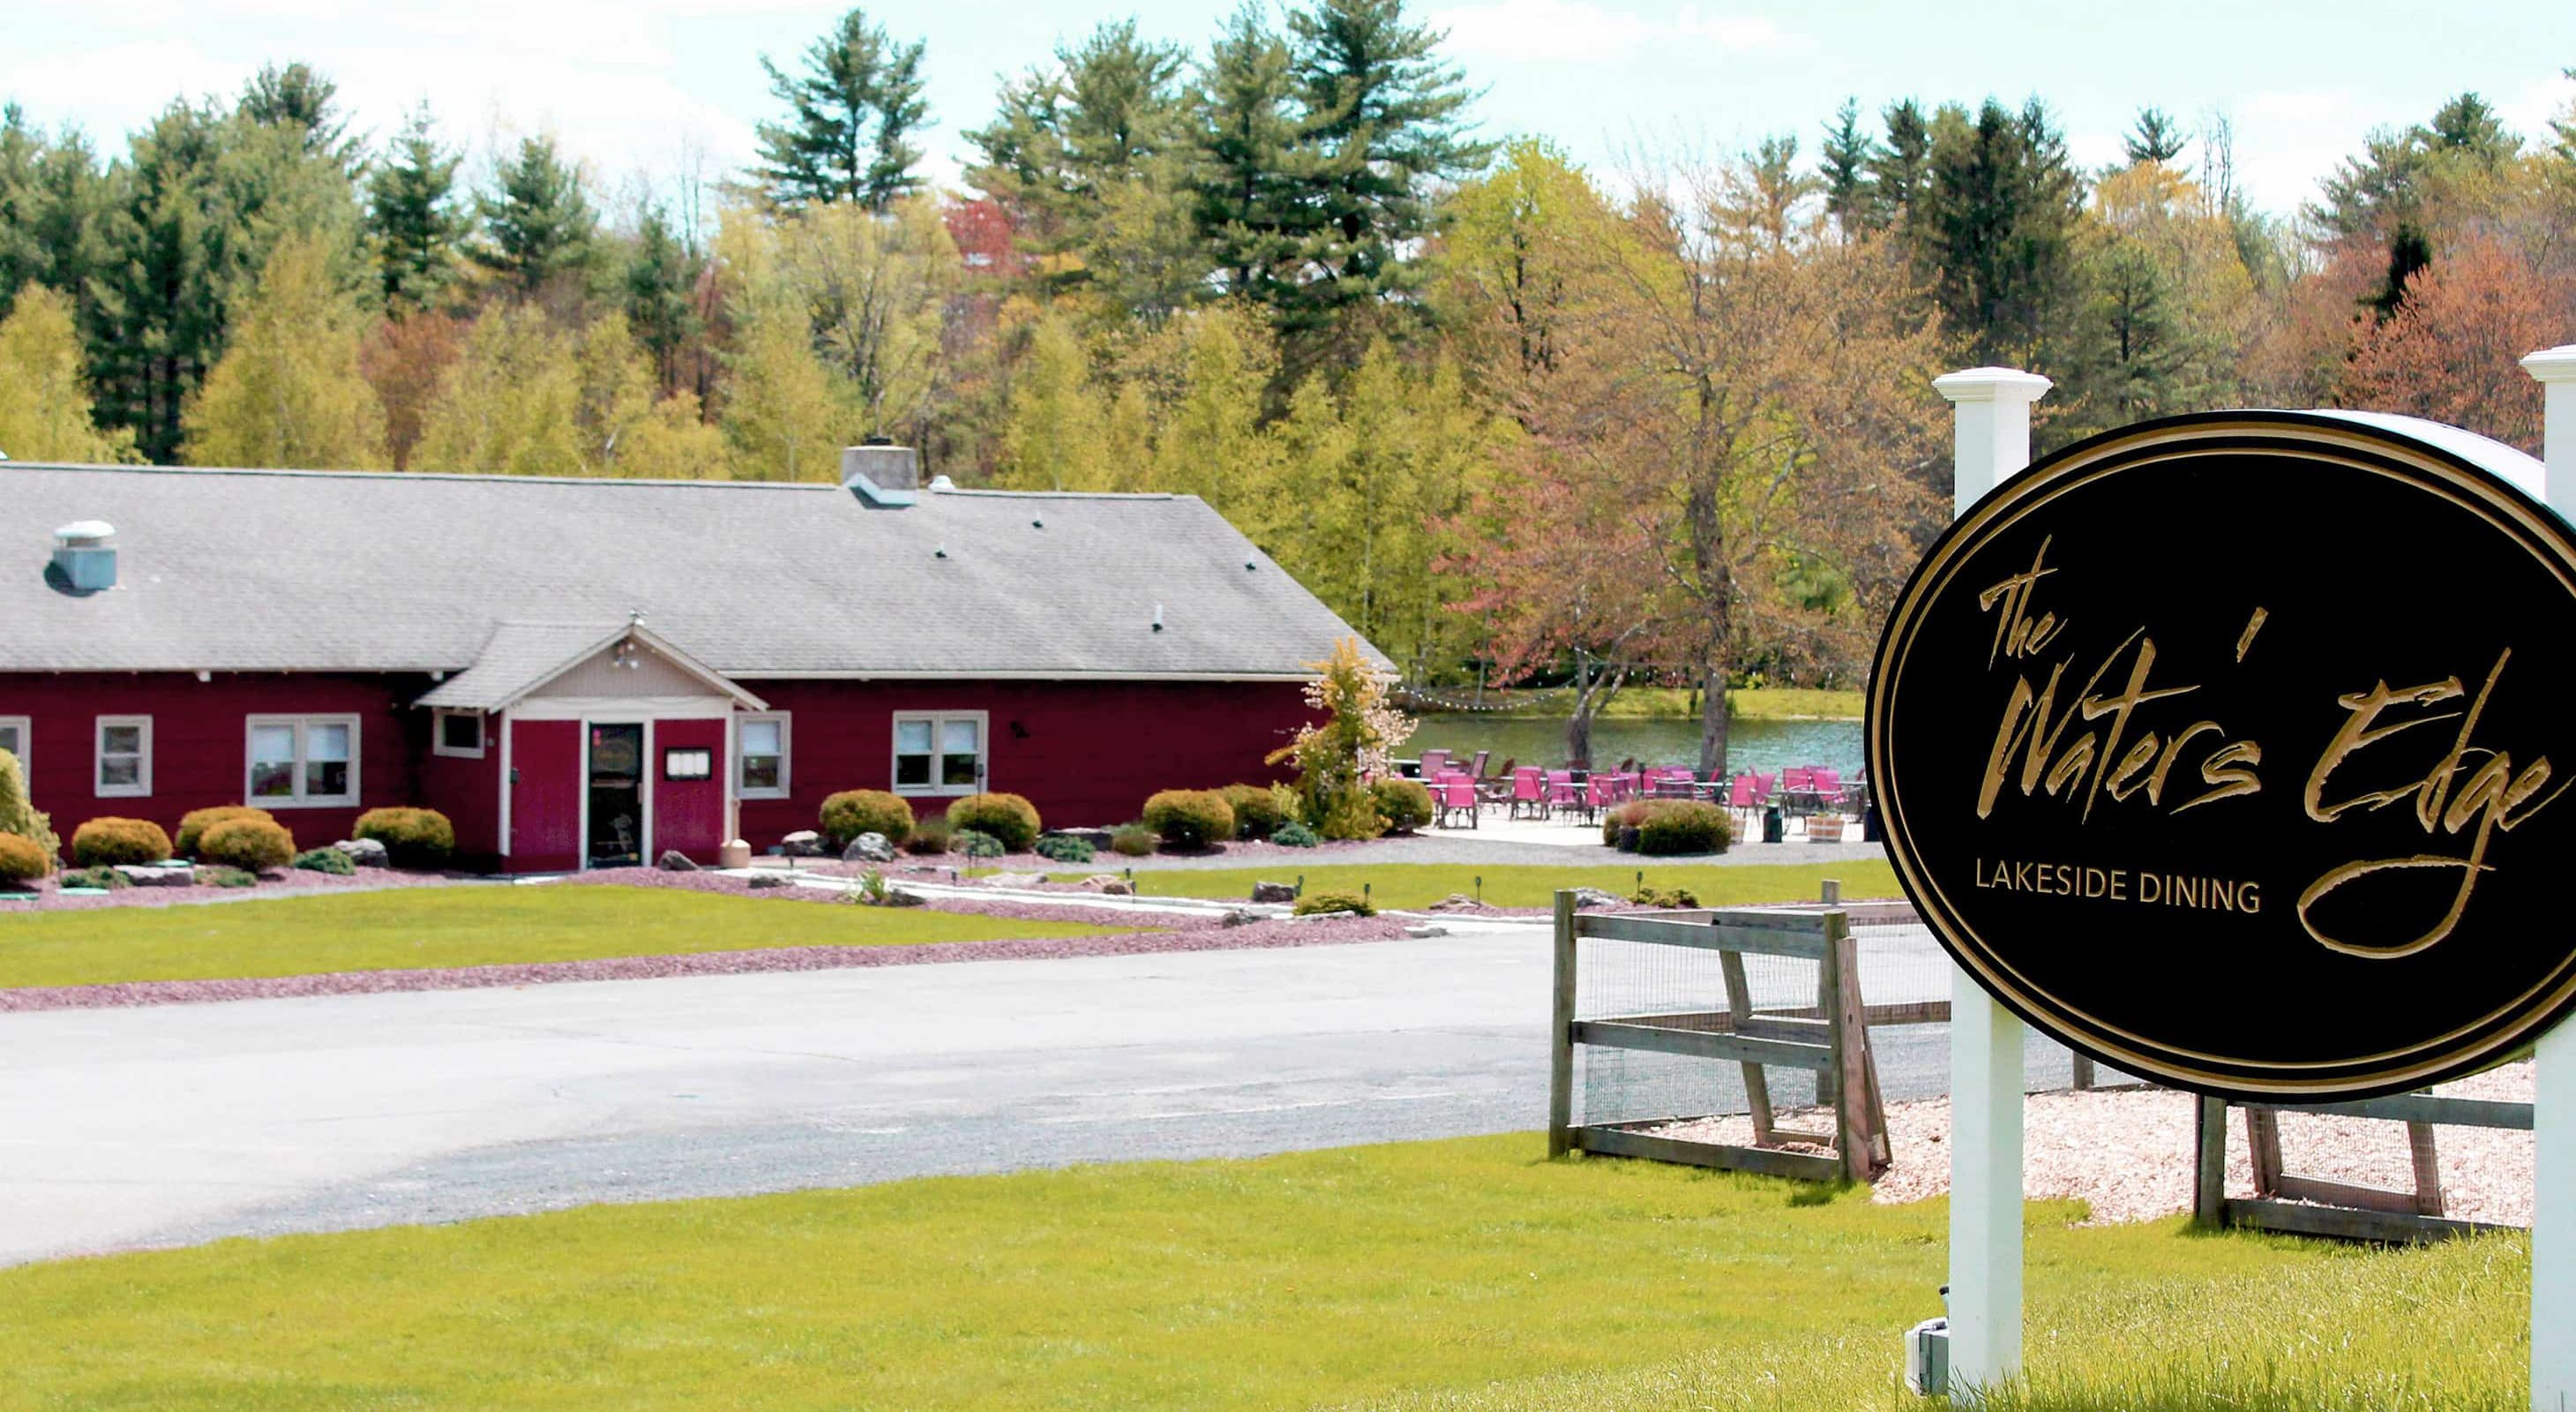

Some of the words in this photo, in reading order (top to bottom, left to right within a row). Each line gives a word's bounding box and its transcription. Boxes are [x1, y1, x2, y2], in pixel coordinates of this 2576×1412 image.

[1979, 533, 2068, 672] The
[1976, 606, 2268, 825] Water's
[2296, 647, 2576, 960] Edge
[1976, 857, 2127, 901] LAKESIDE
[2139, 872, 2260, 914] DINING
